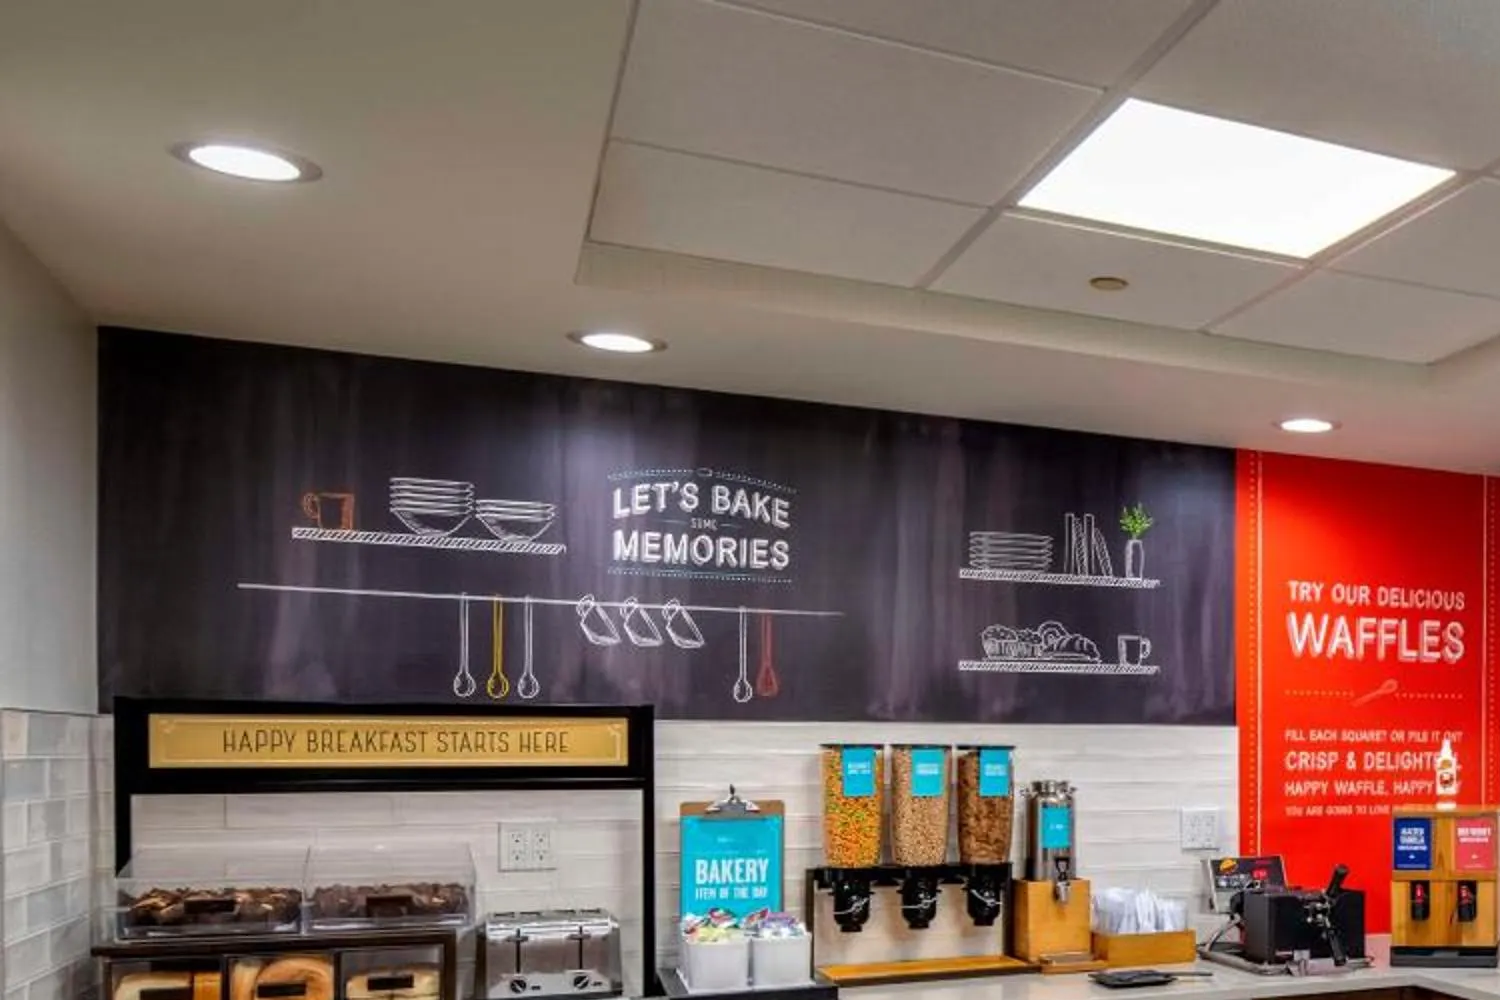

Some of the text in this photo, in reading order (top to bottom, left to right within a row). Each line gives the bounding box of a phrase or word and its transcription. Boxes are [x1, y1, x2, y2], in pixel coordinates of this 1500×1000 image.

[613, 481, 790, 529] LET'S BAKE
[613, 529, 790, 570] MEMORIES
[1288, 580, 1465, 611] TRY OUR DELICIOUS
[1287, 612, 1466, 664] WAFFLES
[223, 729, 569, 754] HAPPY BREAKFAST STARTS HERE
[1285, 729, 1305, 742] FILL
[1309, 729, 1337, 742] EACH
[1391, 730, 1405, 743] OR
[1285, 751, 1339, 770] CRISP
[1346, 751, 1356, 770] &
[1285, 780, 1328, 796] HAPPY
[1393, 780, 1434, 796] HAPPY
[694, 857, 769, 885] BAKERY
[695, 887, 716, 900] ITEM
